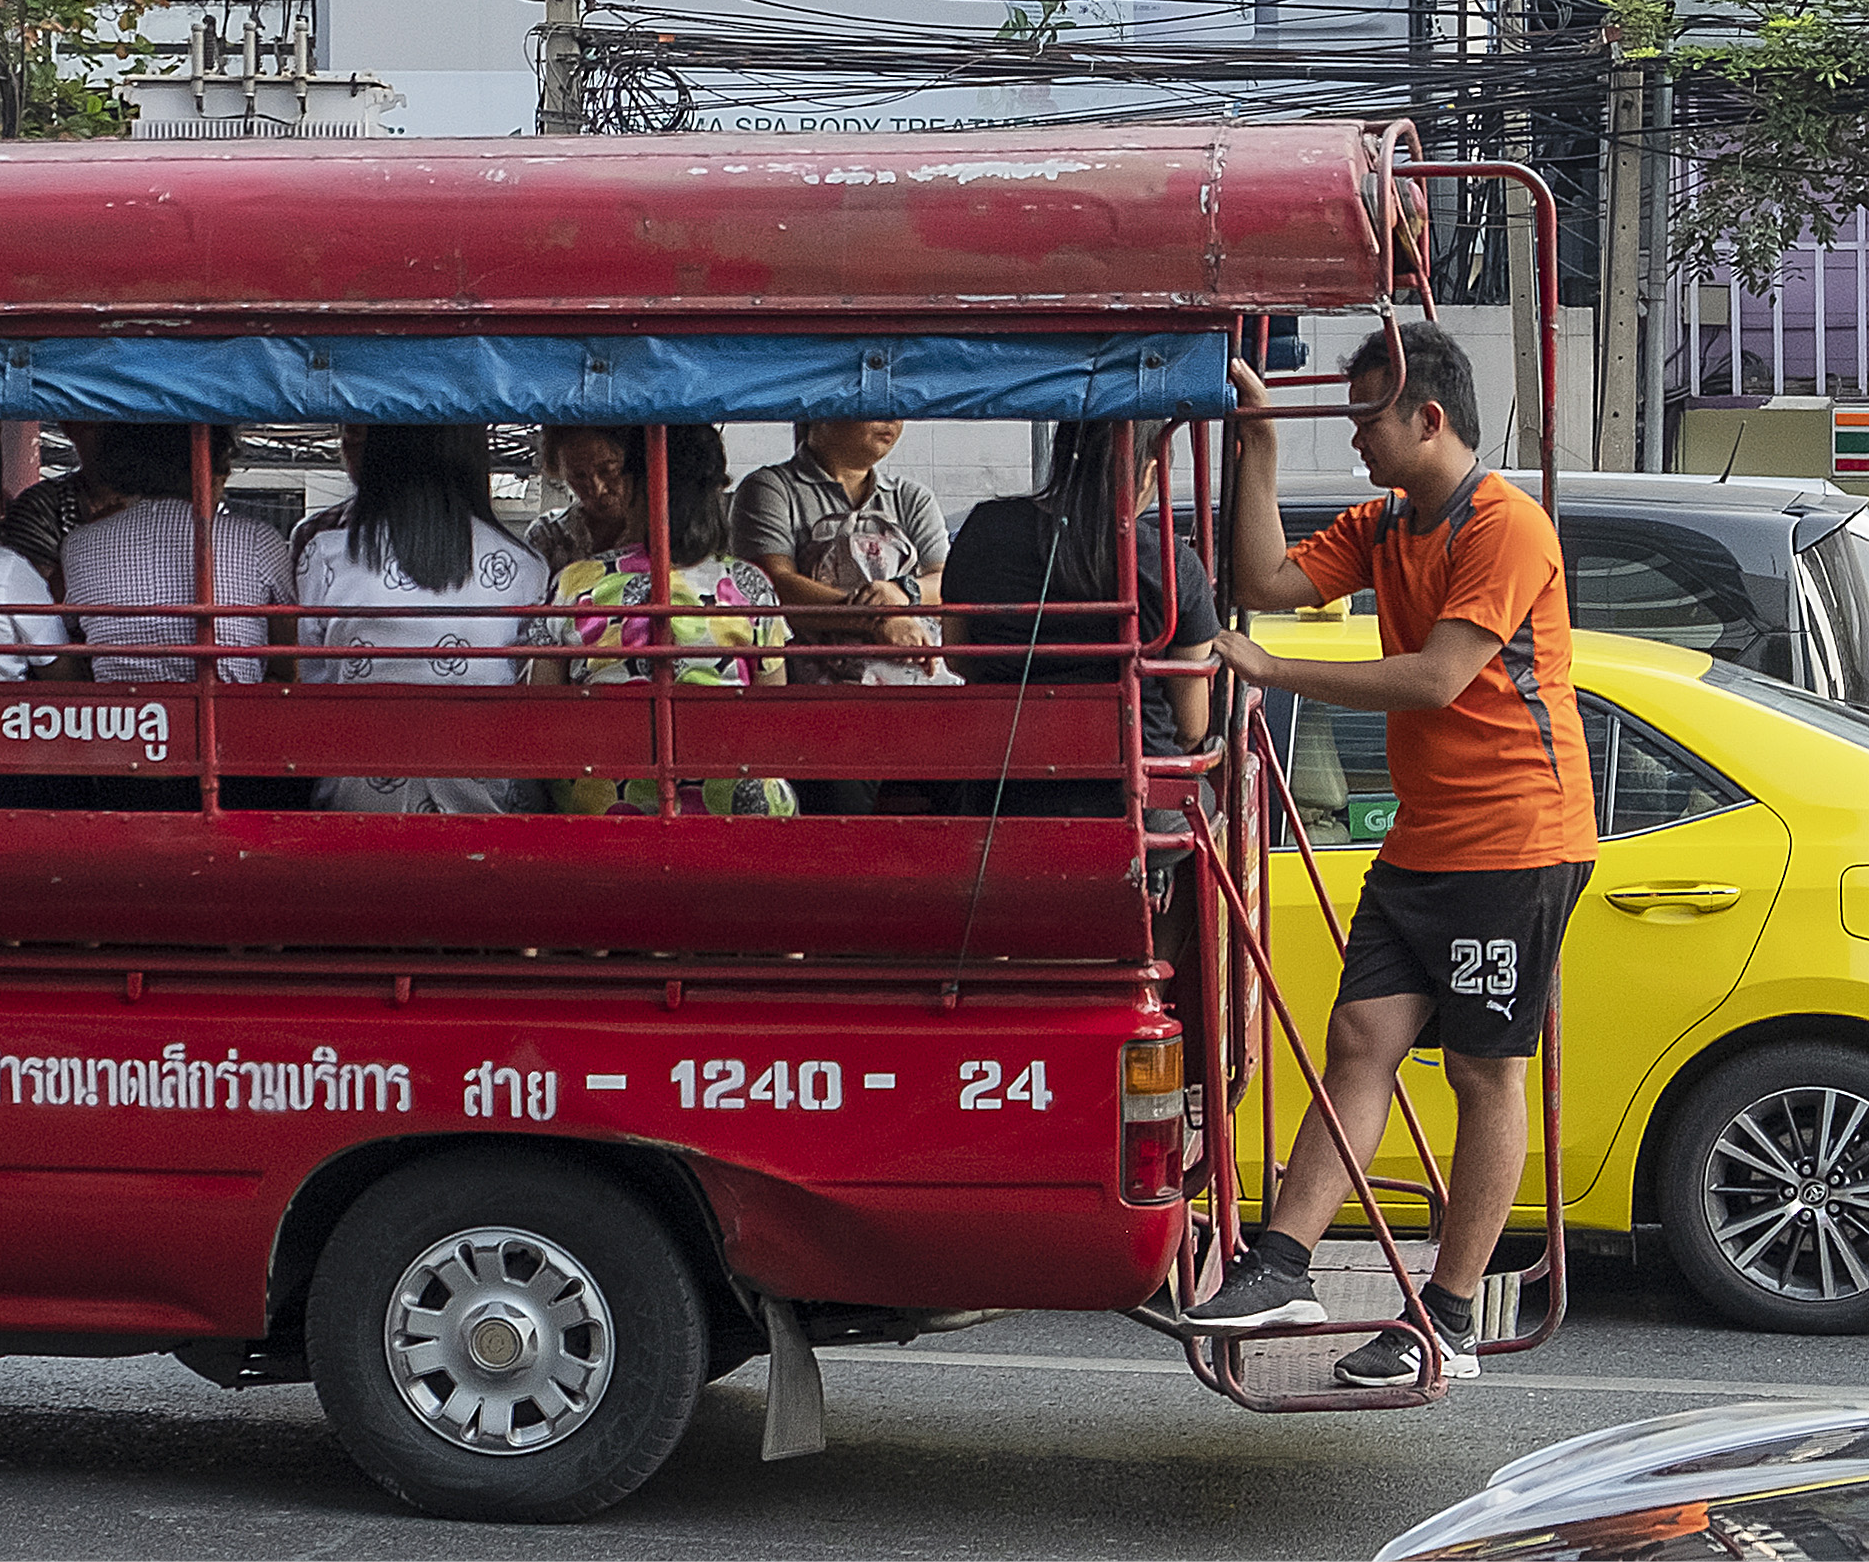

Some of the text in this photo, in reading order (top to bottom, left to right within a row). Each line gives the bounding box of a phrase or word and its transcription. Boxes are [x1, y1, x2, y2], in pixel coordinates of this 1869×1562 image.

[1, 701, 170, 761] สวนพลู
[1449, 939, 1519, 995] 23
[463, 1060, 557, 1121] สาย
[670, 1058, 843, 1111] 1240
[959, 1060, 1053, 1111] 24
